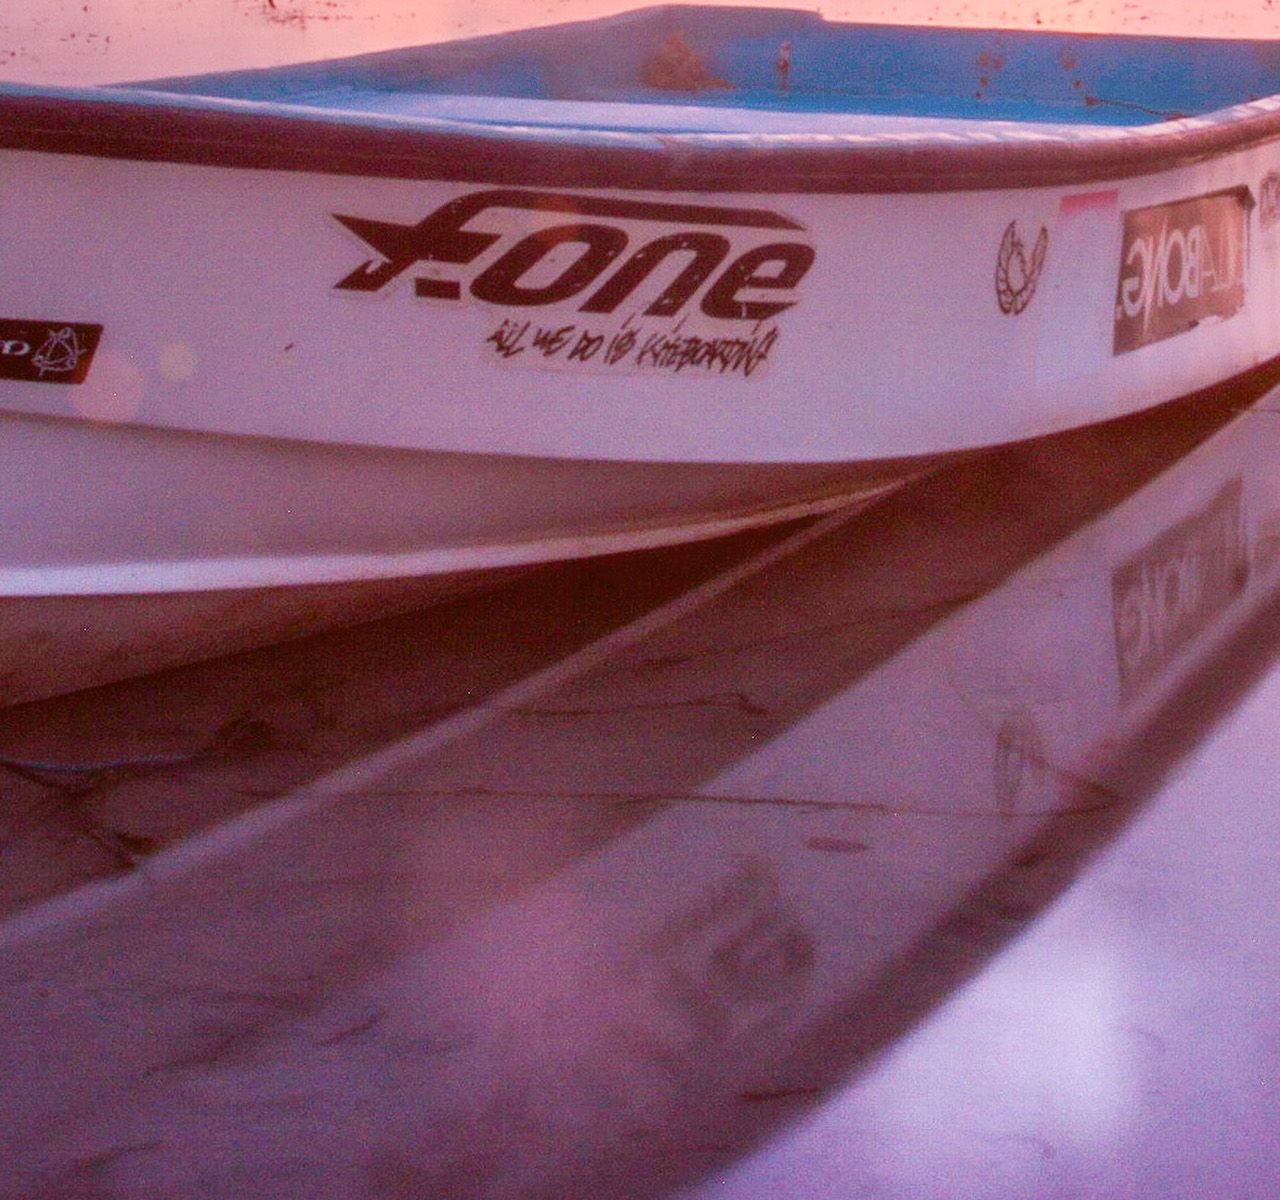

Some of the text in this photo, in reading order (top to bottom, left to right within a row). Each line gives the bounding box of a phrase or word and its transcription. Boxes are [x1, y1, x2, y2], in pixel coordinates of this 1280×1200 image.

[487, 318, 531, 358] ALL
[533, 323, 576, 357] WE
[568, 328, 605, 363] DO
